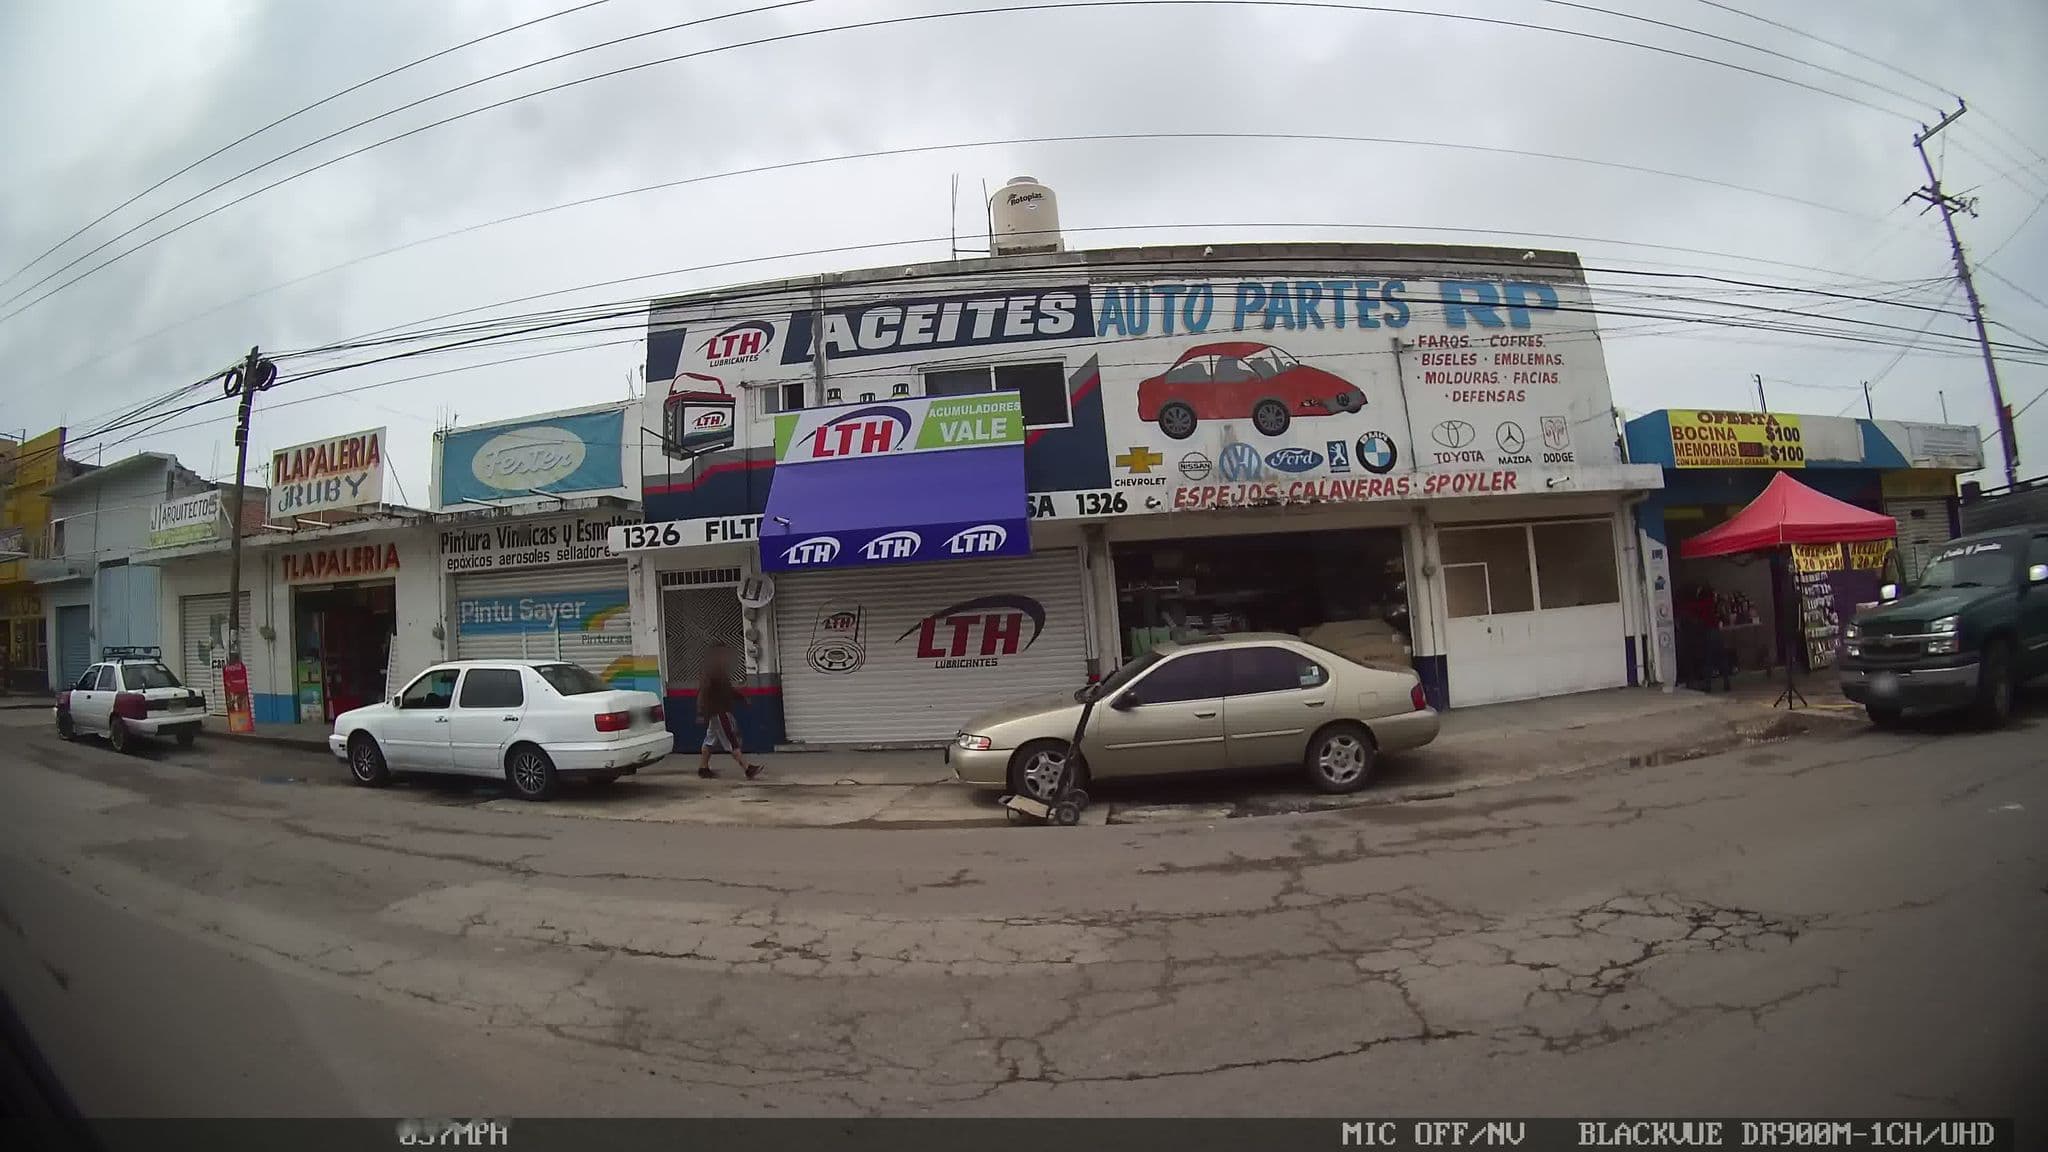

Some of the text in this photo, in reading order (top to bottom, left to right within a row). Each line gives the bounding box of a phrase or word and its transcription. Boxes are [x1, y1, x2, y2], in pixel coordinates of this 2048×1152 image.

[1097, 278, 1559, 337] AUTO PARTES RP
[806, 291, 1077, 355] ACEITES
[706, 331, 762, 360] LTH
[709, 354, 759, 367] LUBRICANTES
[1421, 353, 1477, 366] BISELES
[1452, 390, 1526, 402] DEFENSAS
[928, 401, 1021, 418] ACUMULADORES
[1697, 411, 1779, 426] OFERTA
[812, 419, 894, 458] LTH
[940, 418, 1007, 443] VALE
[1360, 431, 1388, 445] BMW
[1672, 425, 1800, 443] BOCINA $100
[274, 433, 380, 486] TLAPALERIA
[1271, 449, 1315, 467] Ford
[1434, 452, 1485, 464] TOYOTA
[1498, 455, 1533, 465] MAZDA
[1543, 452, 1574, 463] DODGE
[1674, 442, 1737, 457] MEMORIAS
[1770, 445, 1804, 463] $100
[1180, 463, 1211, 471] NISSAN
[1114, 477, 1167, 487] CHEVROLET
[1174, 471, 1517, 508] ESPEJOS CALAVERAS SPOYLER
[1076, 492, 1128, 515] 1326
[441, 530, 491, 555] Pintura
[563, 524, 572, 547] y
[623, 524, 680, 549] 1326
[951, 532, 996, 554] LTH
[499, 548, 550, 566] aerosoles
[788, 544, 831, 564] LTH
[866, 538, 911, 560] LTH
[282, 542, 400, 581] TLAPALERIA
[462, 598, 586, 628] Pintu Sayer
[824, 616, 851, 630] LTH
[582, 634, 632, 645] Pinturas
[917, 613, 1023, 658] LTH
[935, 658, 998, 669] LUBRICANTES
